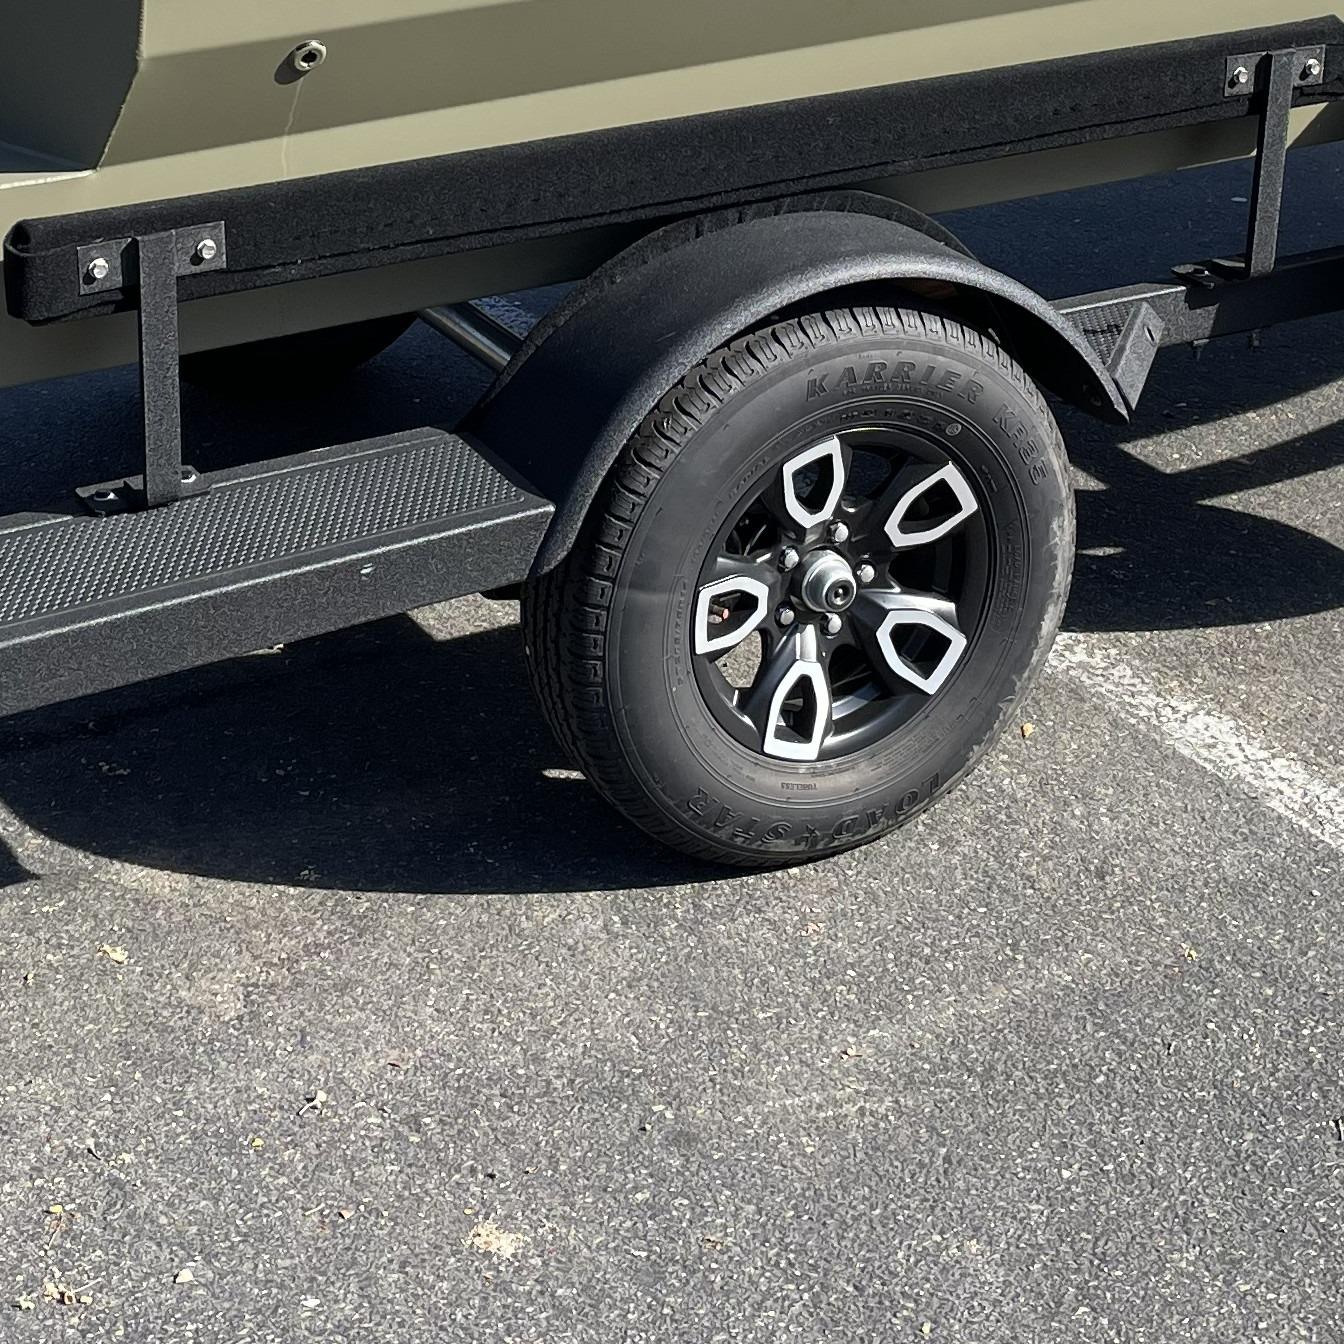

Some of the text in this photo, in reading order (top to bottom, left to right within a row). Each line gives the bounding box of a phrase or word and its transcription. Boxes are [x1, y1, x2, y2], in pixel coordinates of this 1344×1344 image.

[805, 360, 986, 404] KARRIER
[686, 771, 941, 845] LOAD STAR
